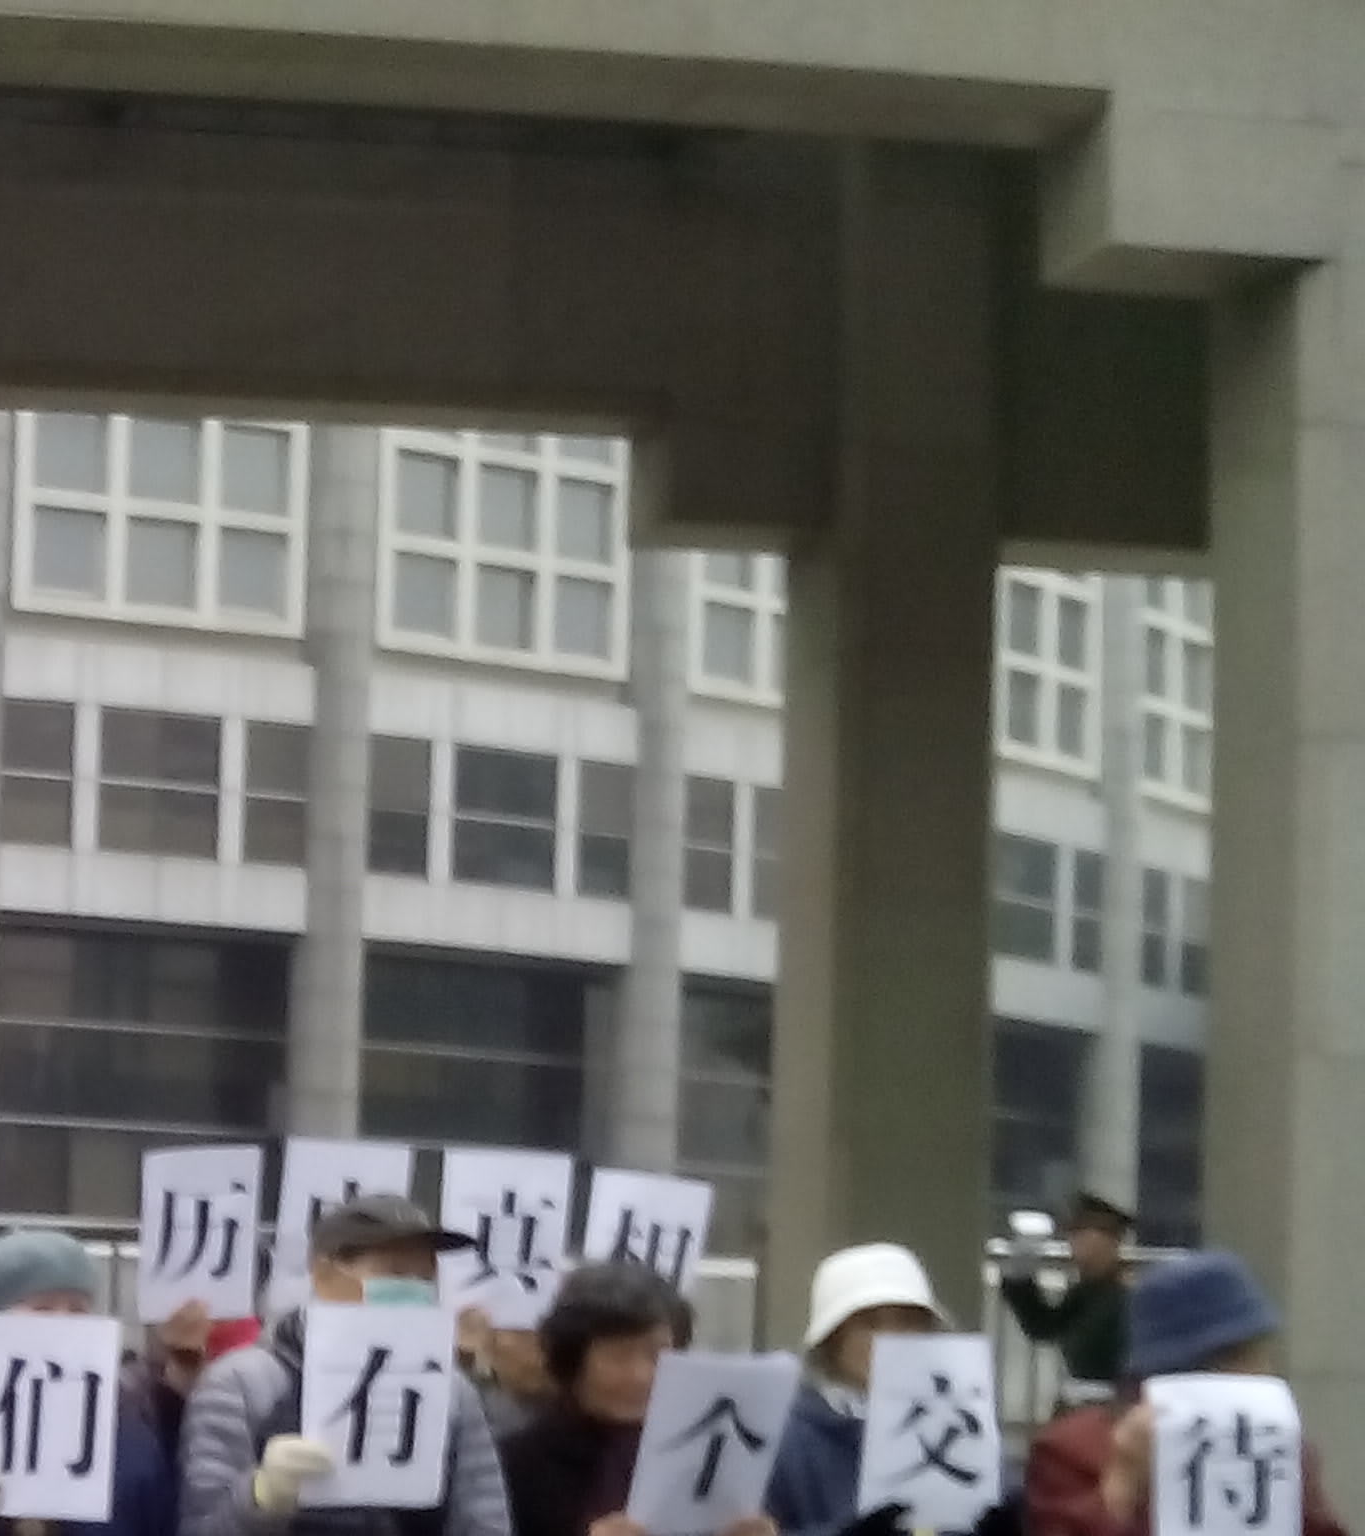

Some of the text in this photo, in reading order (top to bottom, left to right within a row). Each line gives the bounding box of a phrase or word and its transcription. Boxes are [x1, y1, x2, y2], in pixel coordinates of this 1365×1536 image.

[152, 1181, 248, 1280] 历
[462, 1190, 556, 1292] 真
[662, 1396, 766, 1501] 个
[887, 1371, 985, 1485] 交
[1169, 1411, 1292, 1530] 待
